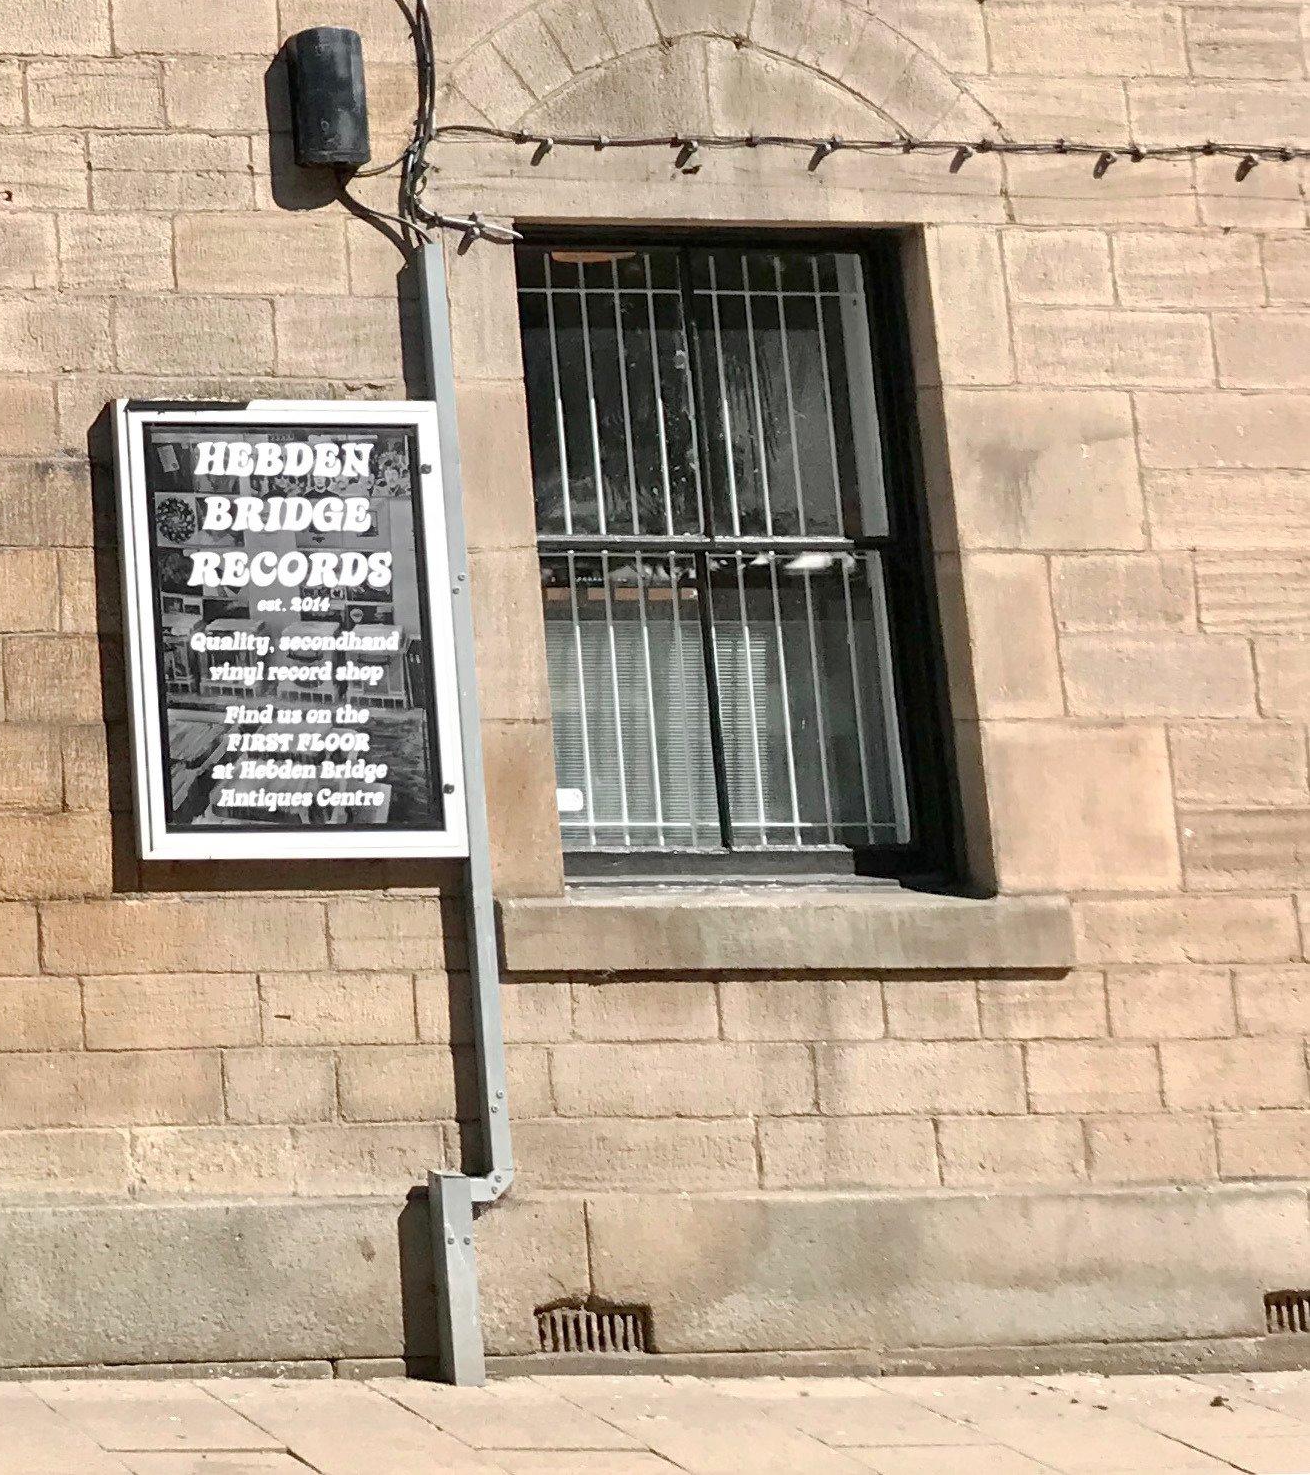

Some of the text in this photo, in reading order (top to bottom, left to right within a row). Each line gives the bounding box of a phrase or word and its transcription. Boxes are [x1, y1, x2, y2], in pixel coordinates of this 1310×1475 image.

[194, 441, 375, 477] HEBDEN
[201, 496, 372, 532] BRIDGE
[186, 550, 393, 588] RECORDS
[257, 596, 331, 612] est. 2014
[190, 630, 400, 656] Quality, secondhand
[209, 661, 384, 686] vinyl record shop
[224, 703, 370, 724] Find us on the
[226, 732, 370, 752] FIRST FLOOR
[211, 758, 388, 783] at Hebden Bridge
[217, 787, 385, 812] Antiques Centre
